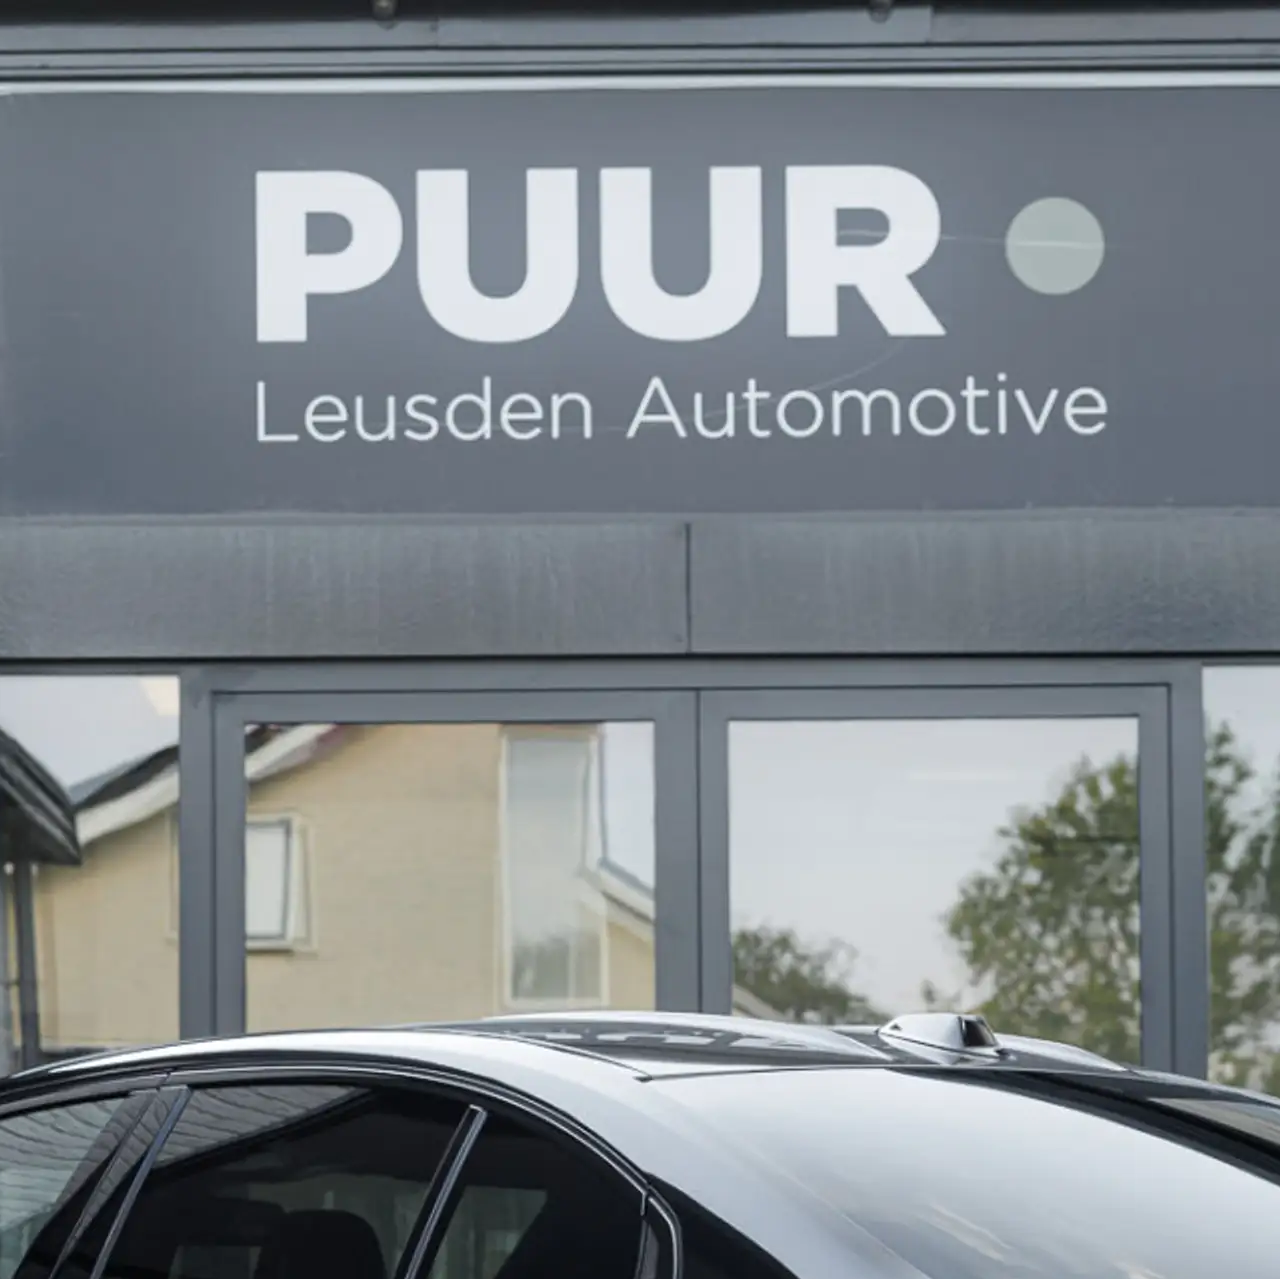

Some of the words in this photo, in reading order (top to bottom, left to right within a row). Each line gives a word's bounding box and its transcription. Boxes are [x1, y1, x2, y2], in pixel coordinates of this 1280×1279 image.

[256, 165, 945, 342] PUUR
[257, 375, 593, 442] Leusden
[626, 373, 1108, 439] Automotive
